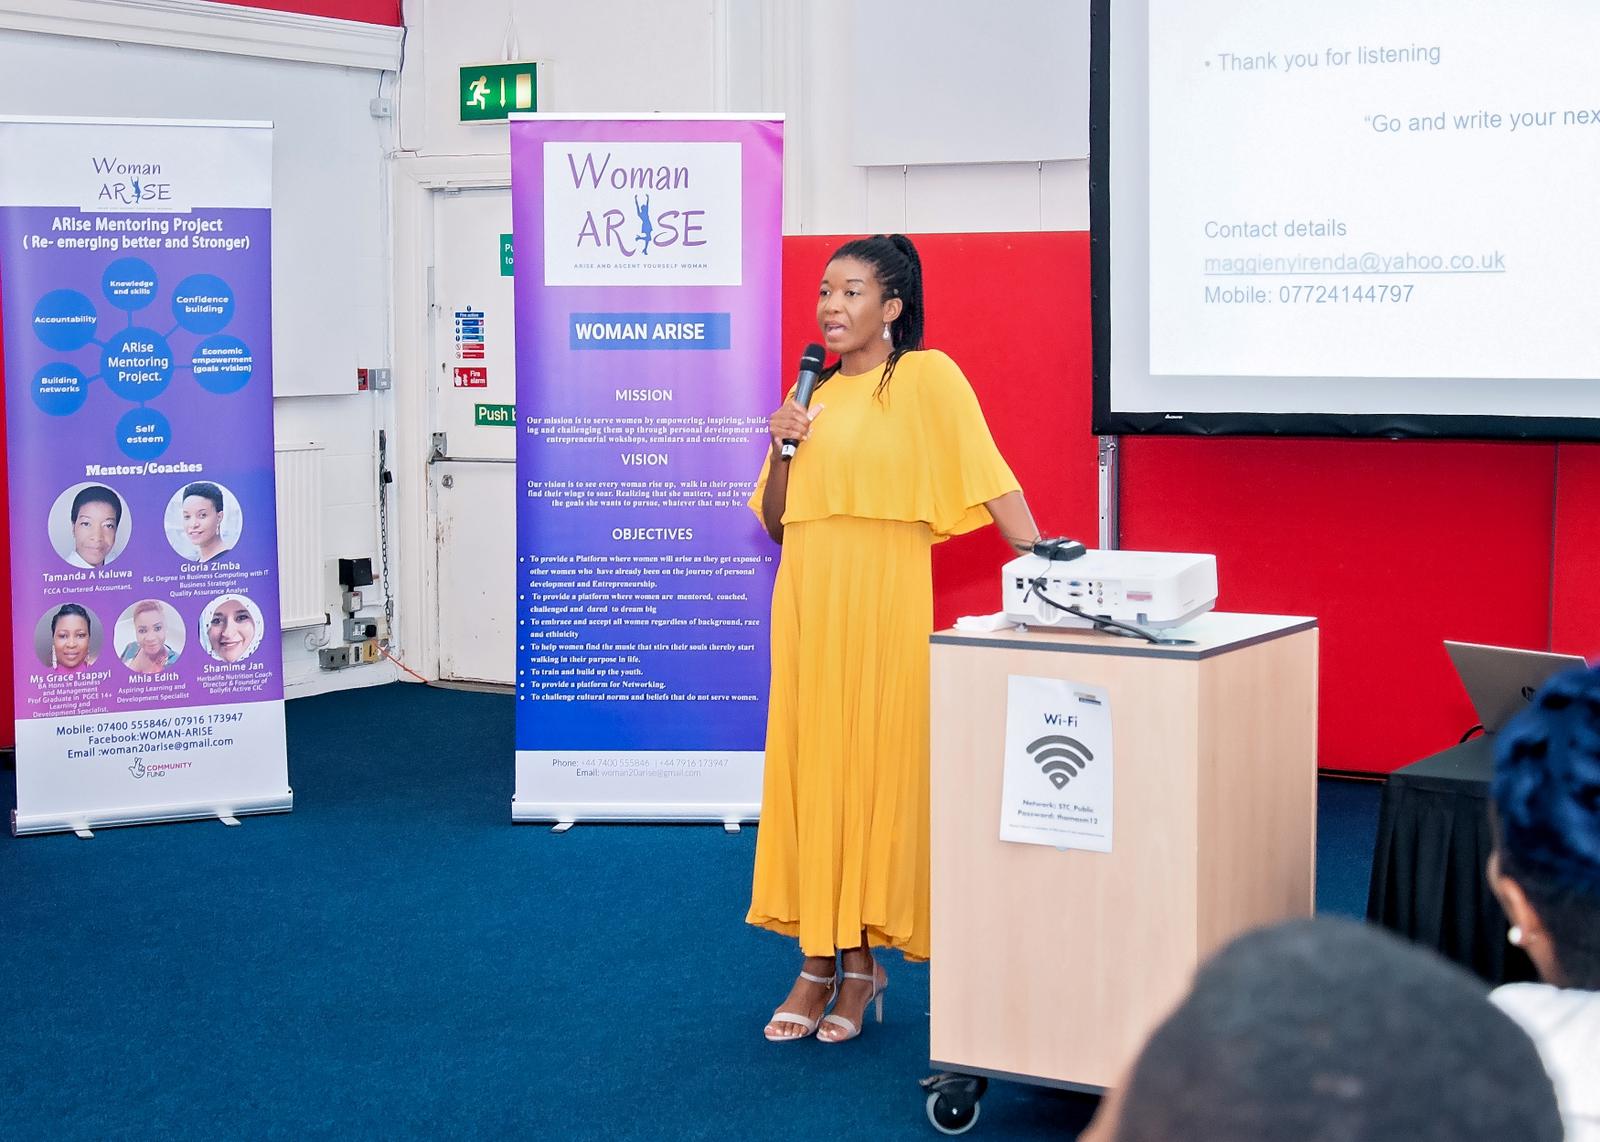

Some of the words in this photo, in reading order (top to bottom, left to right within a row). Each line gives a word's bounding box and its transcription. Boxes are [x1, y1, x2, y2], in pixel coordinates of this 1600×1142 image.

[1218, 51, 1278, 72] Thank
[1284, 53, 1318, 73] you
[1326, 48, 1351, 66] for
[1358, 43, 1441, 65] listening
[1408, 112, 1446, 131] and
[1453, 110, 1502, 129] write
[1510, 111, 1556, 132] your
[1563, 109, 1600, 125] nex
[92, 157, 161, 175] Woman
[567, 152, 689, 190] Woman
[96, 217, 169, 234] Mentoring
[173, 218, 223, 234] Project
[1204, 221, 1277, 238] Contact
[1284, 219, 1347, 237] details
[57, 236, 119, 251] emerging
[122, 235, 162, 248] better
[164, 235, 189, 248] and
[192, 235, 250, 251] Stronger)
[1204, 251, 1505, 274] maggienyirenda@yahoo.co.uk
[110, 280, 154, 289] Knowledge
[113, 288, 129, 296] and
[130, 288, 151, 296] skills
[1204, 285, 1272, 304] Mobile:
[1279, 285, 1414, 303] 07724144797
[176, 295, 229, 304] Confidence
[185, 305, 223, 314] building
[34, 315, 97, 325] Accountability
[575, 323, 647, 340] WOMAN
[652, 323, 705, 340] ARISE
[108, 356, 169, 369] Mentoring
[192, 356, 252, 365] empowerment
[193, 364, 219, 373] (goals
[221, 364, 252, 373] +vision)
[41, 376, 78, 386] Building
[118, 371, 163, 384] Project.
[39, 385, 80, 393] networks
[615, 390, 672, 401] MISSION
[478, 407, 508, 421] Push
[527, 416, 541, 424] Our
[544, 416, 573, 424] mission
[575, 416, 581, 424] is
[584, 416, 592, 424] to
[644, 416, 654, 426] by
[656, 416, 705, 426] empowering,
[707, 416, 745, 426] inspiring,
[746, 416, 769, 424] build-
[135, 425, 155, 433] Self
[527, 426, 539, 435] ing
[541, 426, 555, 434] and
[557, 426, 602, 435] challenging
[603, 426, 623, 434] them
[625, 427, 635, 435] up
[636, 426, 667, 435] through
[669, 426, 703, 435] personal
[704, 426, 753, 435] development
[755, 426, 769, 434] and
[126, 435, 164, 444] esteem
[546, 436, 607, 444] entrepreneurial
[621, 454, 668, 465] VISION
[85, 461, 203, 477] Mentors/Coaches
[612, 528, 692, 540] OBJECTIVES
[180, 563, 209, 573] Gloria
[211, 561, 240, 571] Zimba
[43, 572, 86, 582] Tamanda
[89, 571, 96, 579] A
[98, 569, 133, 579] Kaluwa
[155, 574, 178, 583] Degree
[186, 572, 213, 580] Business
[214, 571, 249, 579] Computing
[62, 585, 94, 593] Chartered
[180, 581, 206, 589] Business
[207, 580, 237, 588] Strategist
[169, 589, 192, 598] Quality
[193, 588, 225, 596] Assurance
[225, 587, 249, 596] Analyst
[249, 661, 264, 671] Jan
[30, 674, 44, 683] Ms
[46, 673, 74, 682] Grace
[154, 671, 179, 682] Edith
[620, 669, 644, 677] youth.
[118, 686, 145, 695] Aspiring
[146, 684, 172, 693] Learning
[541, 681, 569, 689] provide
[576, 681, 608, 689] platform
[622, 681, 666, 690] Networking.
[116, 695, 159, 704] Development
[160, 692, 189, 702] Specialist
[541, 693, 575, 702] challenge
[577, 693, 605, 701] cultural
[646, 693, 669, 701] beliefs
[670, 693, 685, 701] that
[687, 693, 696, 701] do
[56, 724, 95, 736] Mobile:
[97, 722, 128, 733] 07400
[131, 717, 172, 731] 555846/
[174, 715, 205, 726] 07916
[208, 713, 243, 724] 173947
[1044, 713, 1078, 728] Wi-Fi
[67, 748, 95, 760] Email
[146, 761, 192, 771] COMMUNITY
[552, 759, 579, 767] Phone:
[576, 769, 600, 777] Email:
